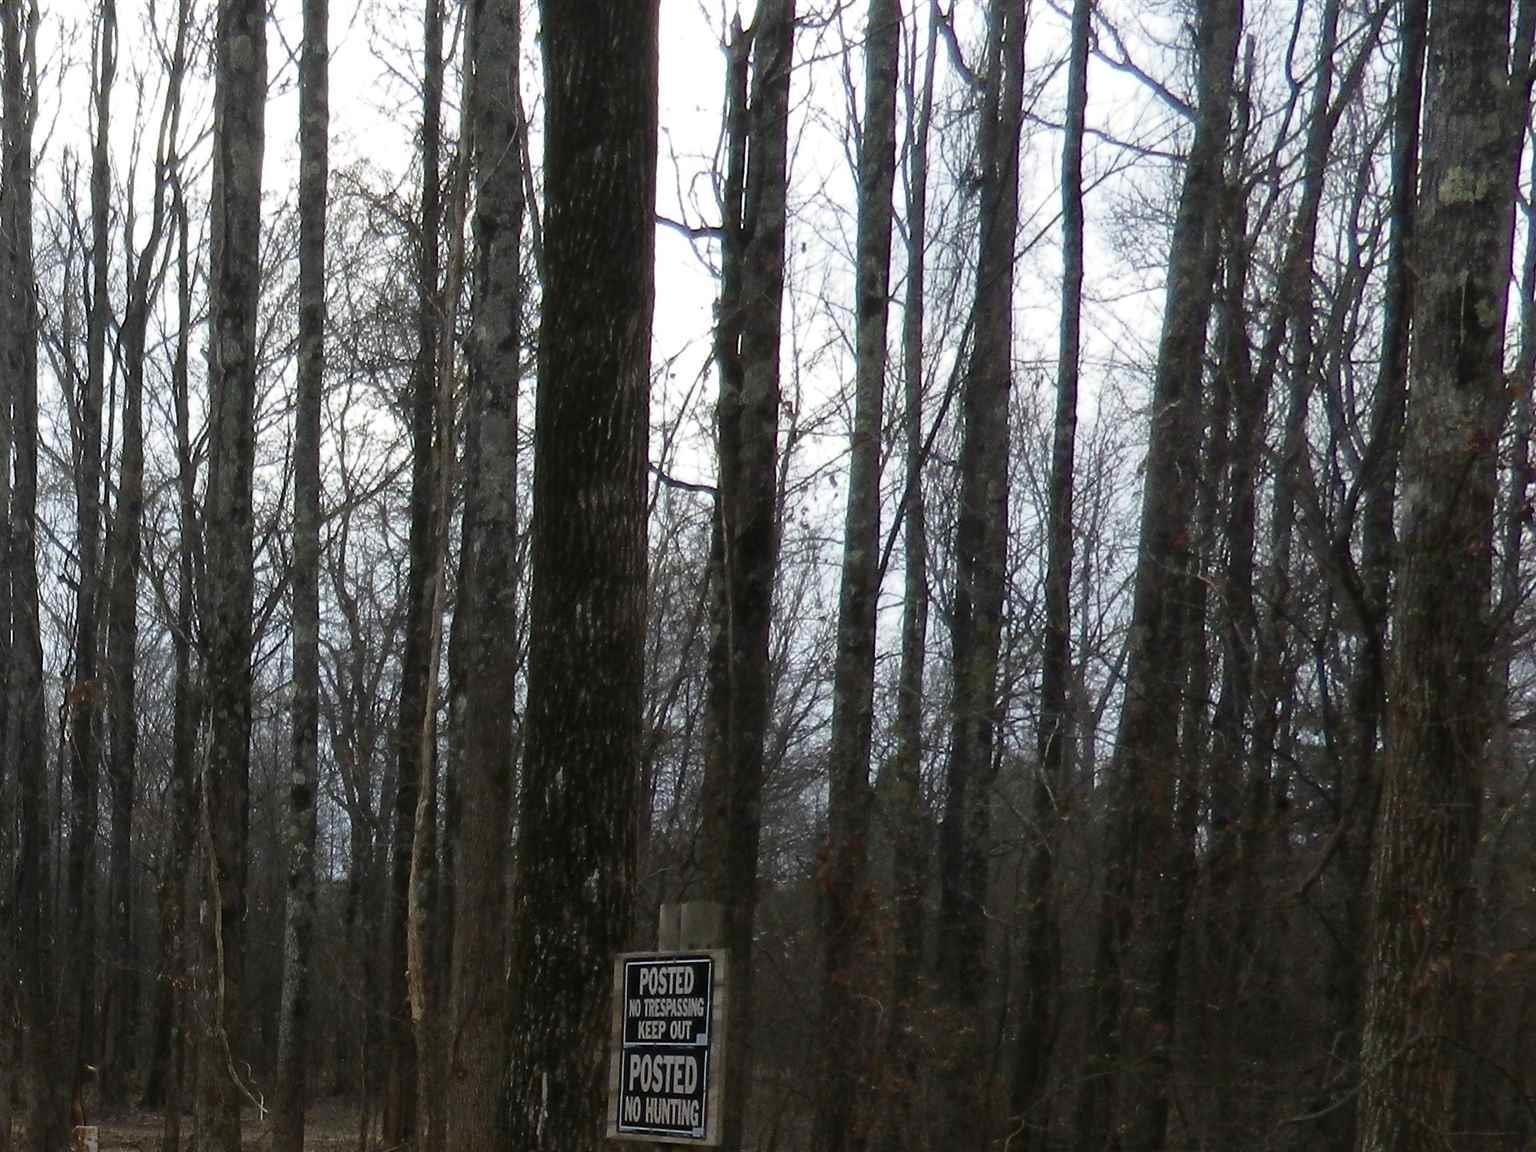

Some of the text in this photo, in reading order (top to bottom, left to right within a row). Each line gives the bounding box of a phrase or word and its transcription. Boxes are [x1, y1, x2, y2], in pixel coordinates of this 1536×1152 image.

[639, 966, 694, 995] POSTED
[629, 997, 704, 1017] NO TRESPASSING
[638, 1020, 693, 1040] KEEP OUT
[629, 1054, 698, 1095] POSTED
[624, 1095, 699, 1127] NO HUNTING
